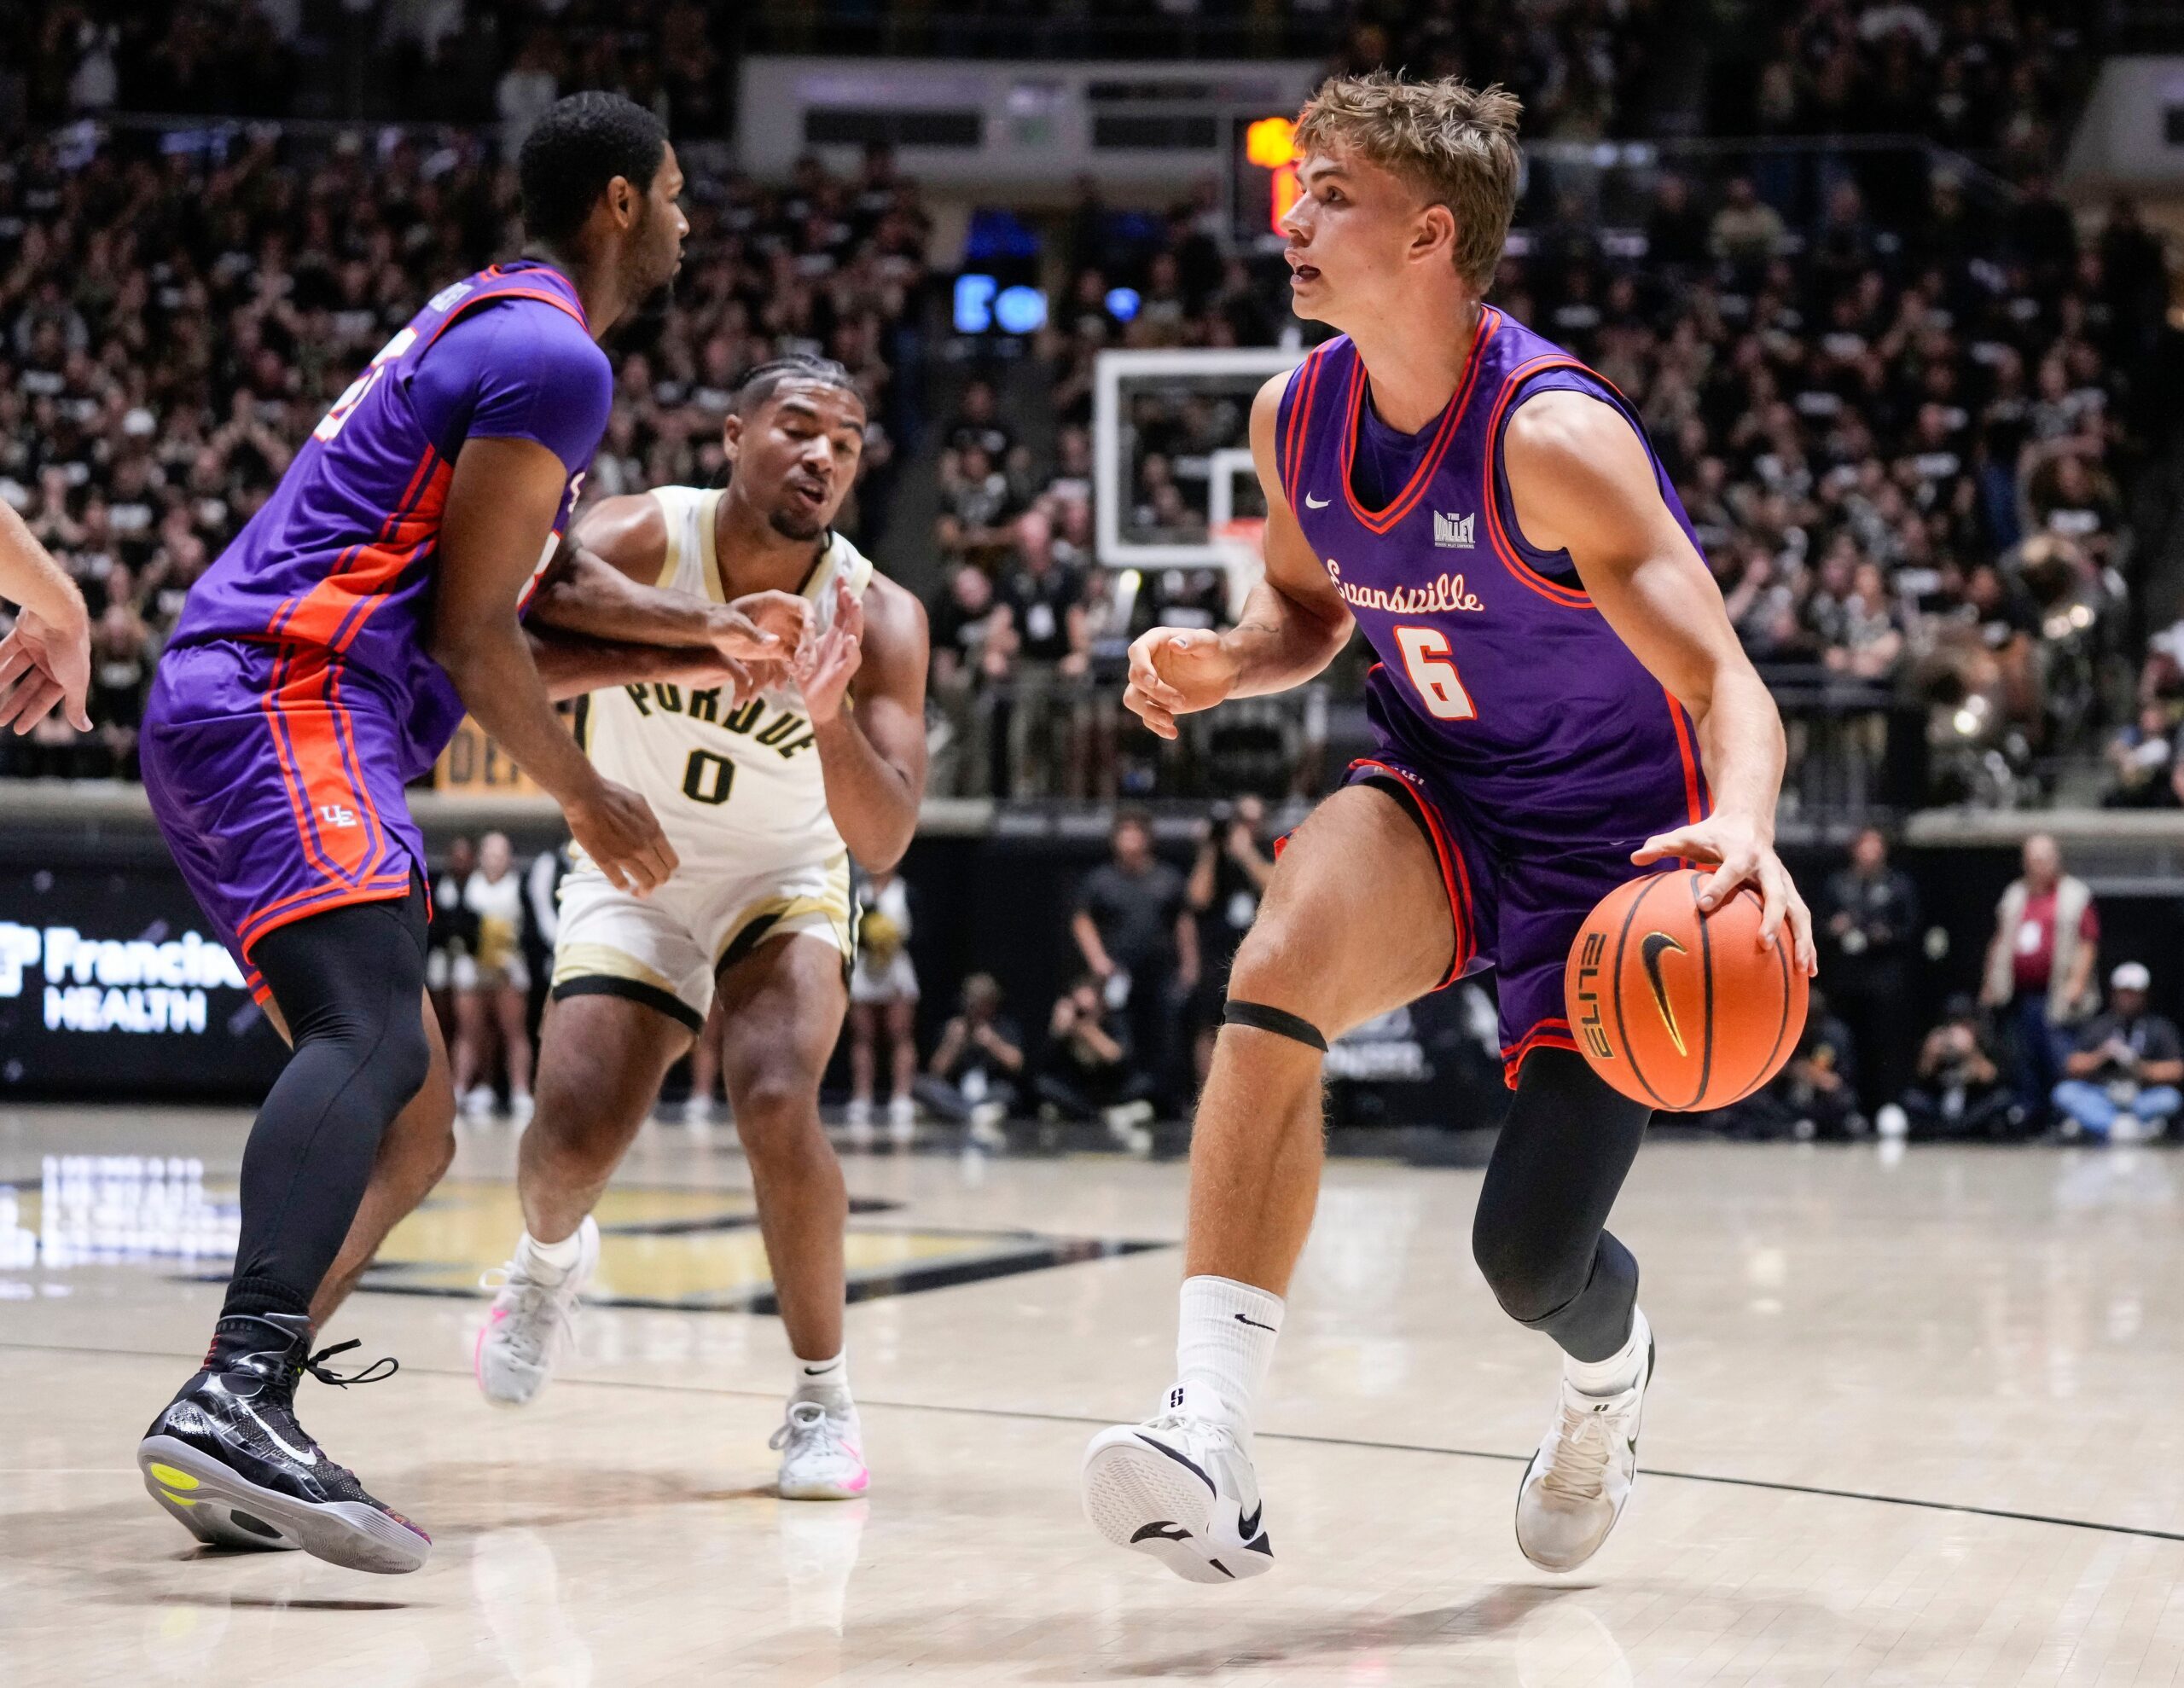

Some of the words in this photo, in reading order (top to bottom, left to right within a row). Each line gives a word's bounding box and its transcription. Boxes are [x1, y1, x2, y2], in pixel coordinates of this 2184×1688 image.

[1433, 510, 1475, 542] VALLEY
[1327, 559, 1484, 614] Evansville
[1393, 624, 1478, 722] 6
[681, 747, 736, 805] 0
[320, 804, 357, 827] UE
[44, 984, 207, 1034] HEALTH
[1578, 932, 1615, 1059] ELITE
